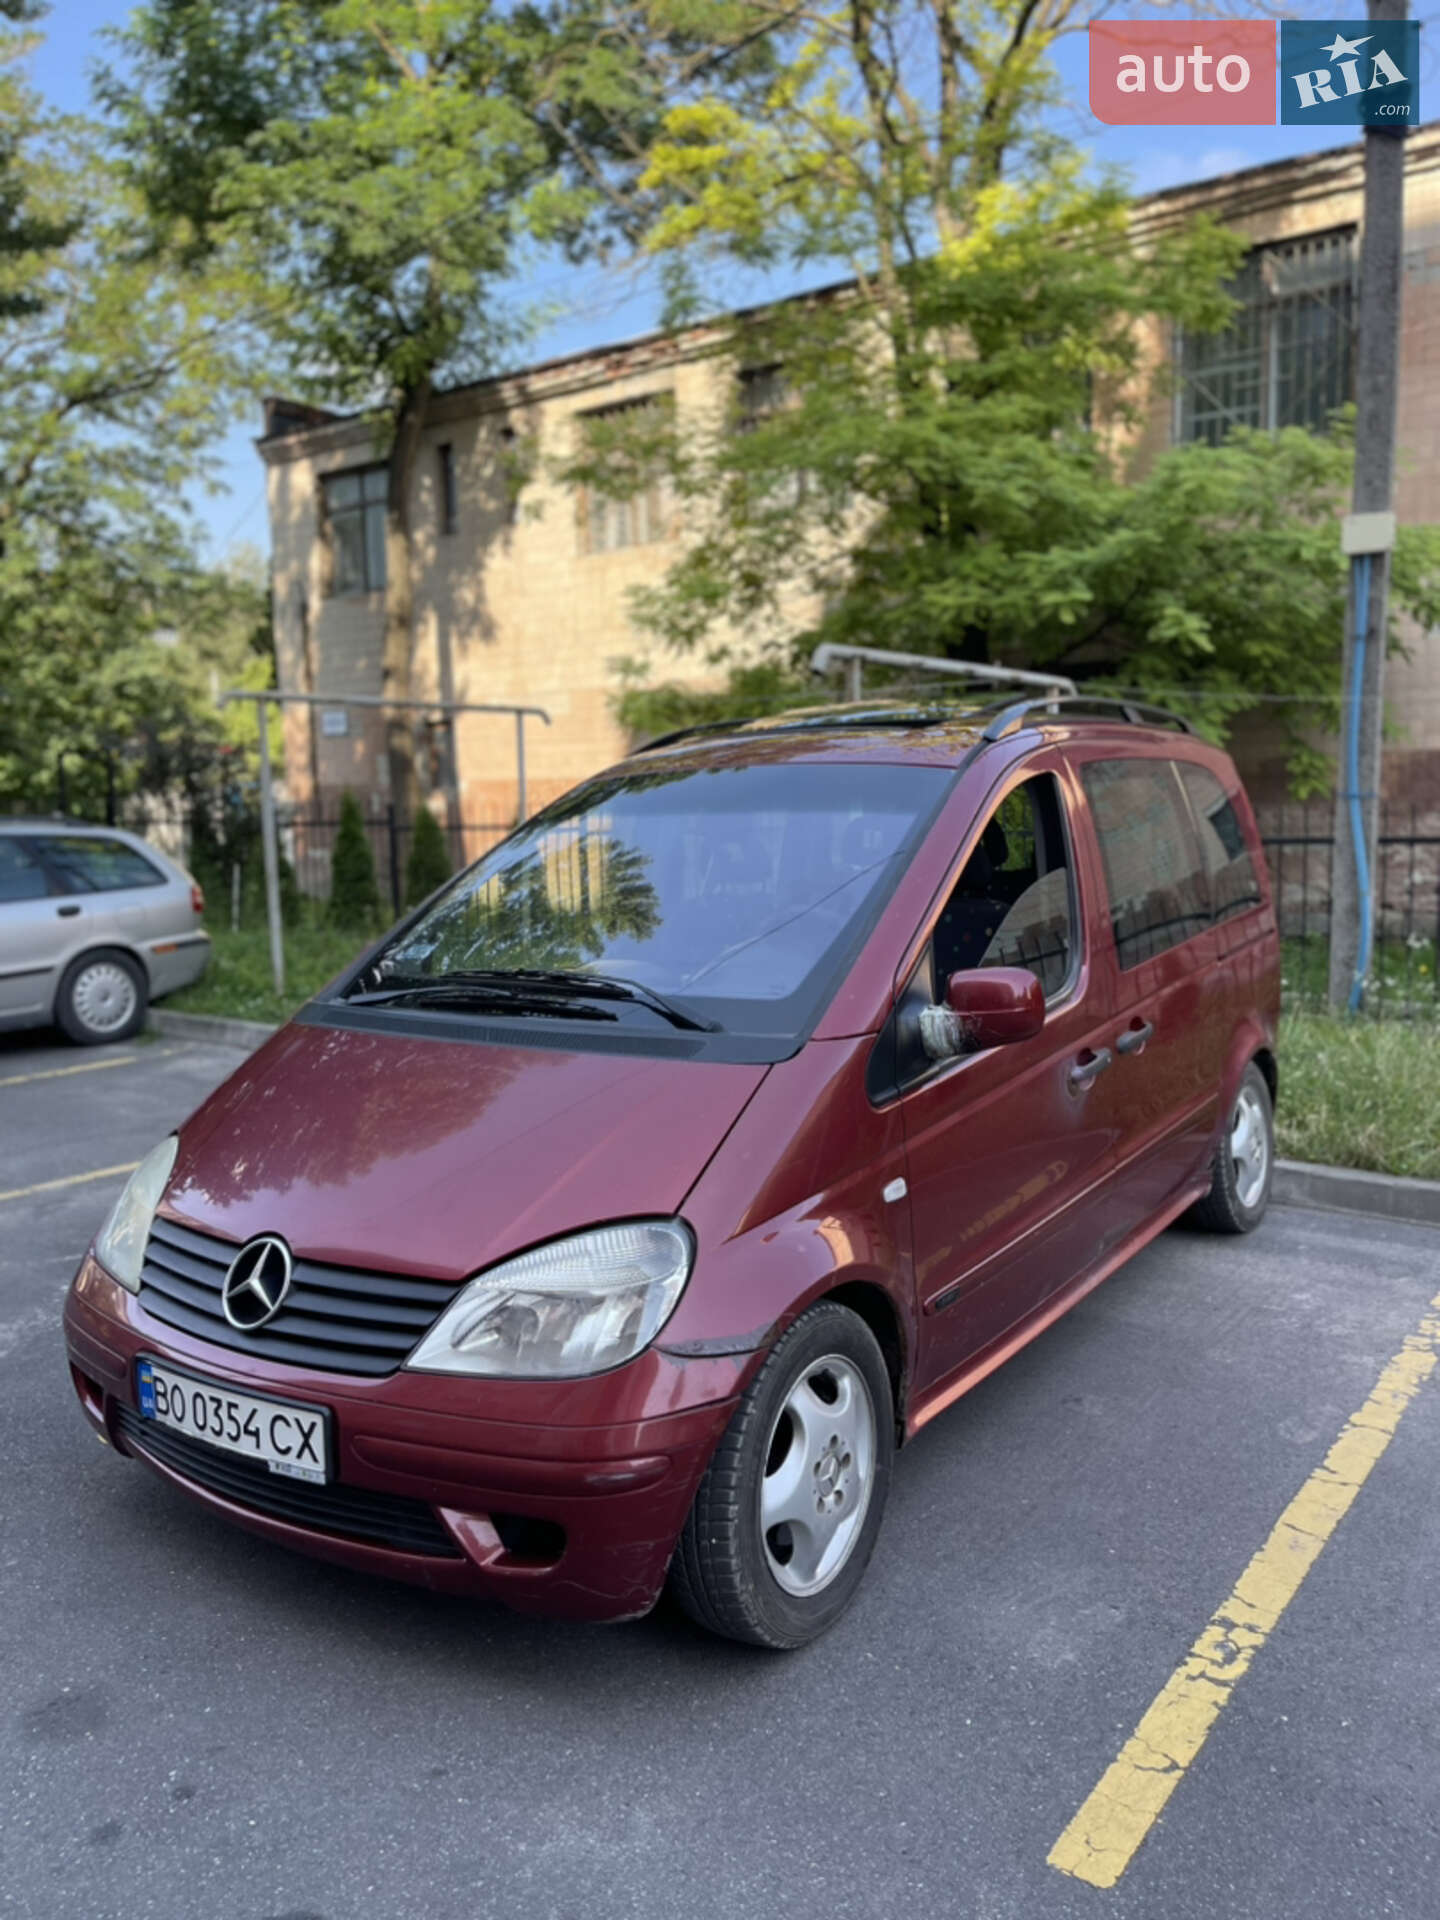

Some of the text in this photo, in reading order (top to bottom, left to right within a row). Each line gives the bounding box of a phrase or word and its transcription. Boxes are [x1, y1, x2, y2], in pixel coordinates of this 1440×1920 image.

[153, 1376, 320, 1465] BO 0354 CX
